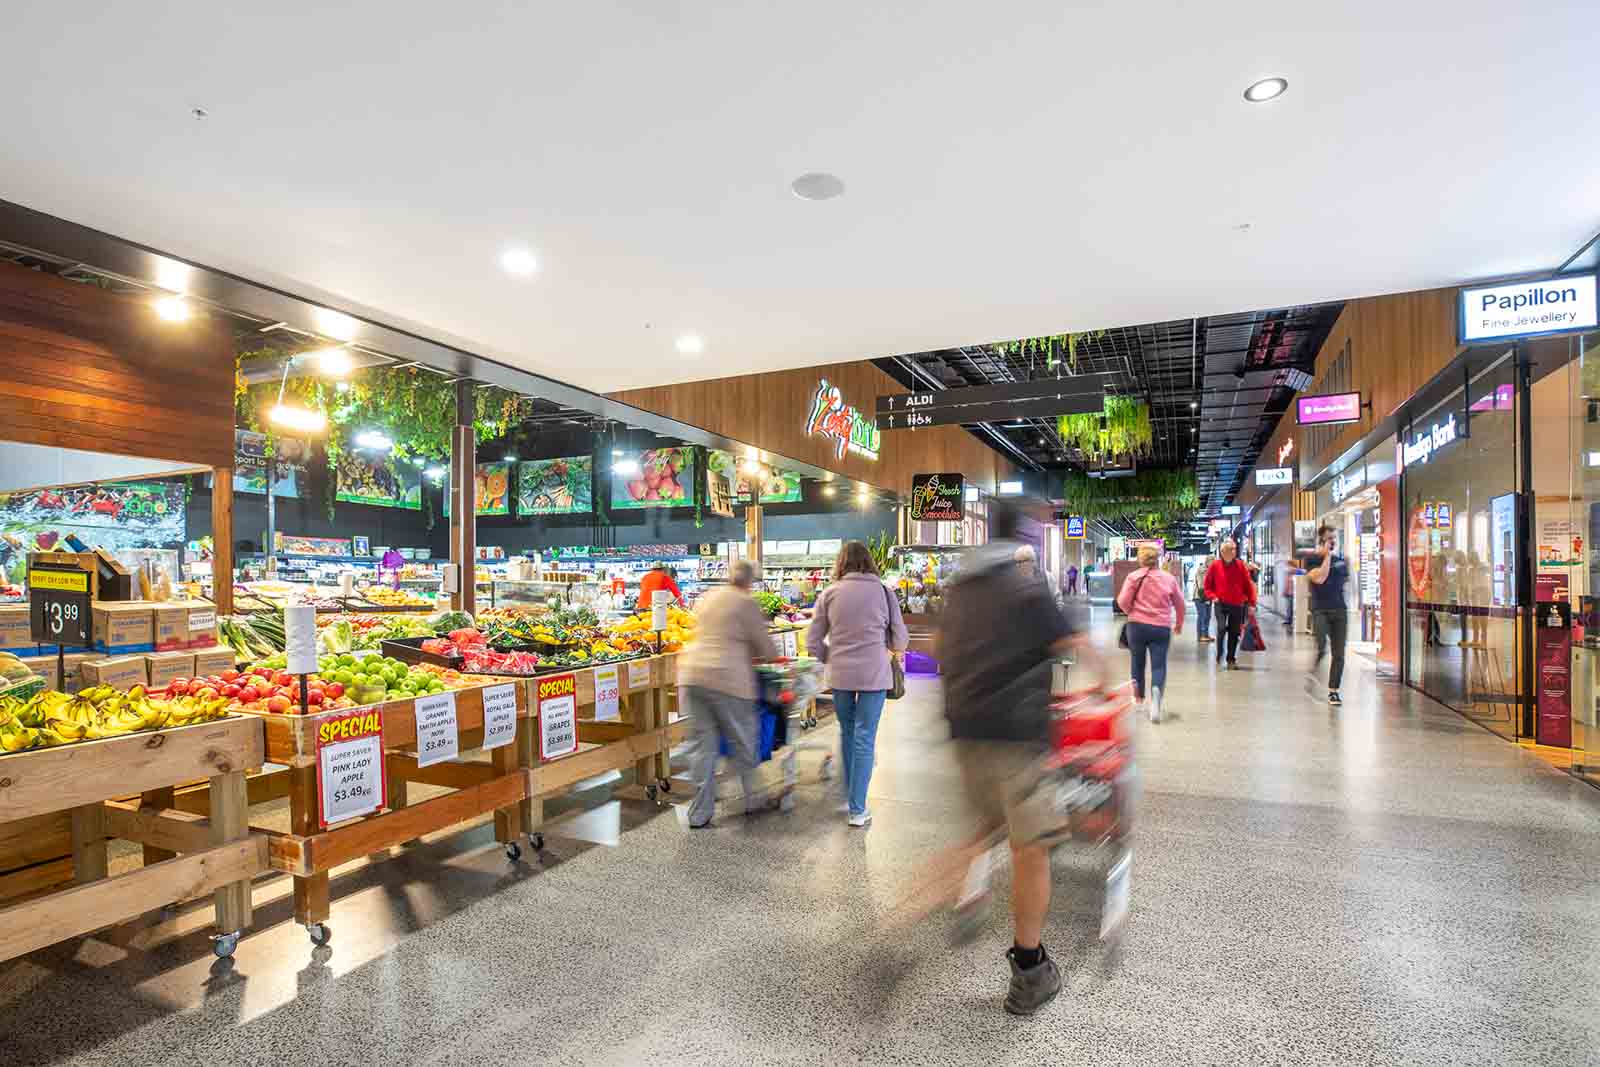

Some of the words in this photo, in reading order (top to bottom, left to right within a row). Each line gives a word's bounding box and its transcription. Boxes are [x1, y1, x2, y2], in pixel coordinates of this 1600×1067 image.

[1482, 288, 1576, 311] Papillon
[1482, 319, 1510, 328] Fine
[1514, 312, 1577, 326] Jewellery
[906, 395, 933, 406] ALDI
[1432, 413, 1456, 450] Bank
[931, 495, 953, 510] Juice
[539, 678, 574, 698] SPECIAL
[485, 694, 499, 703] SUPER
[501, 702, 515, 711] GALA
[425, 711, 448, 720] GRANNY
[319, 712, 382, 743] SPECIAL
[488, 724, 504, 736] $2.99
[505, 723, 513, 731] KG
[548, 720, 571, 731] GRAPES
[431, 730, 446, 738] NOW
[425, 739, 446, 751] $3.49
[331, 751, 351, 762] SUPER
[352, 747, 372, 757] SAVER
[332, 763, 351, 774] PINK
[352, 758, 371, 769] LADY
[341, 771, 364, 784] APPLE
